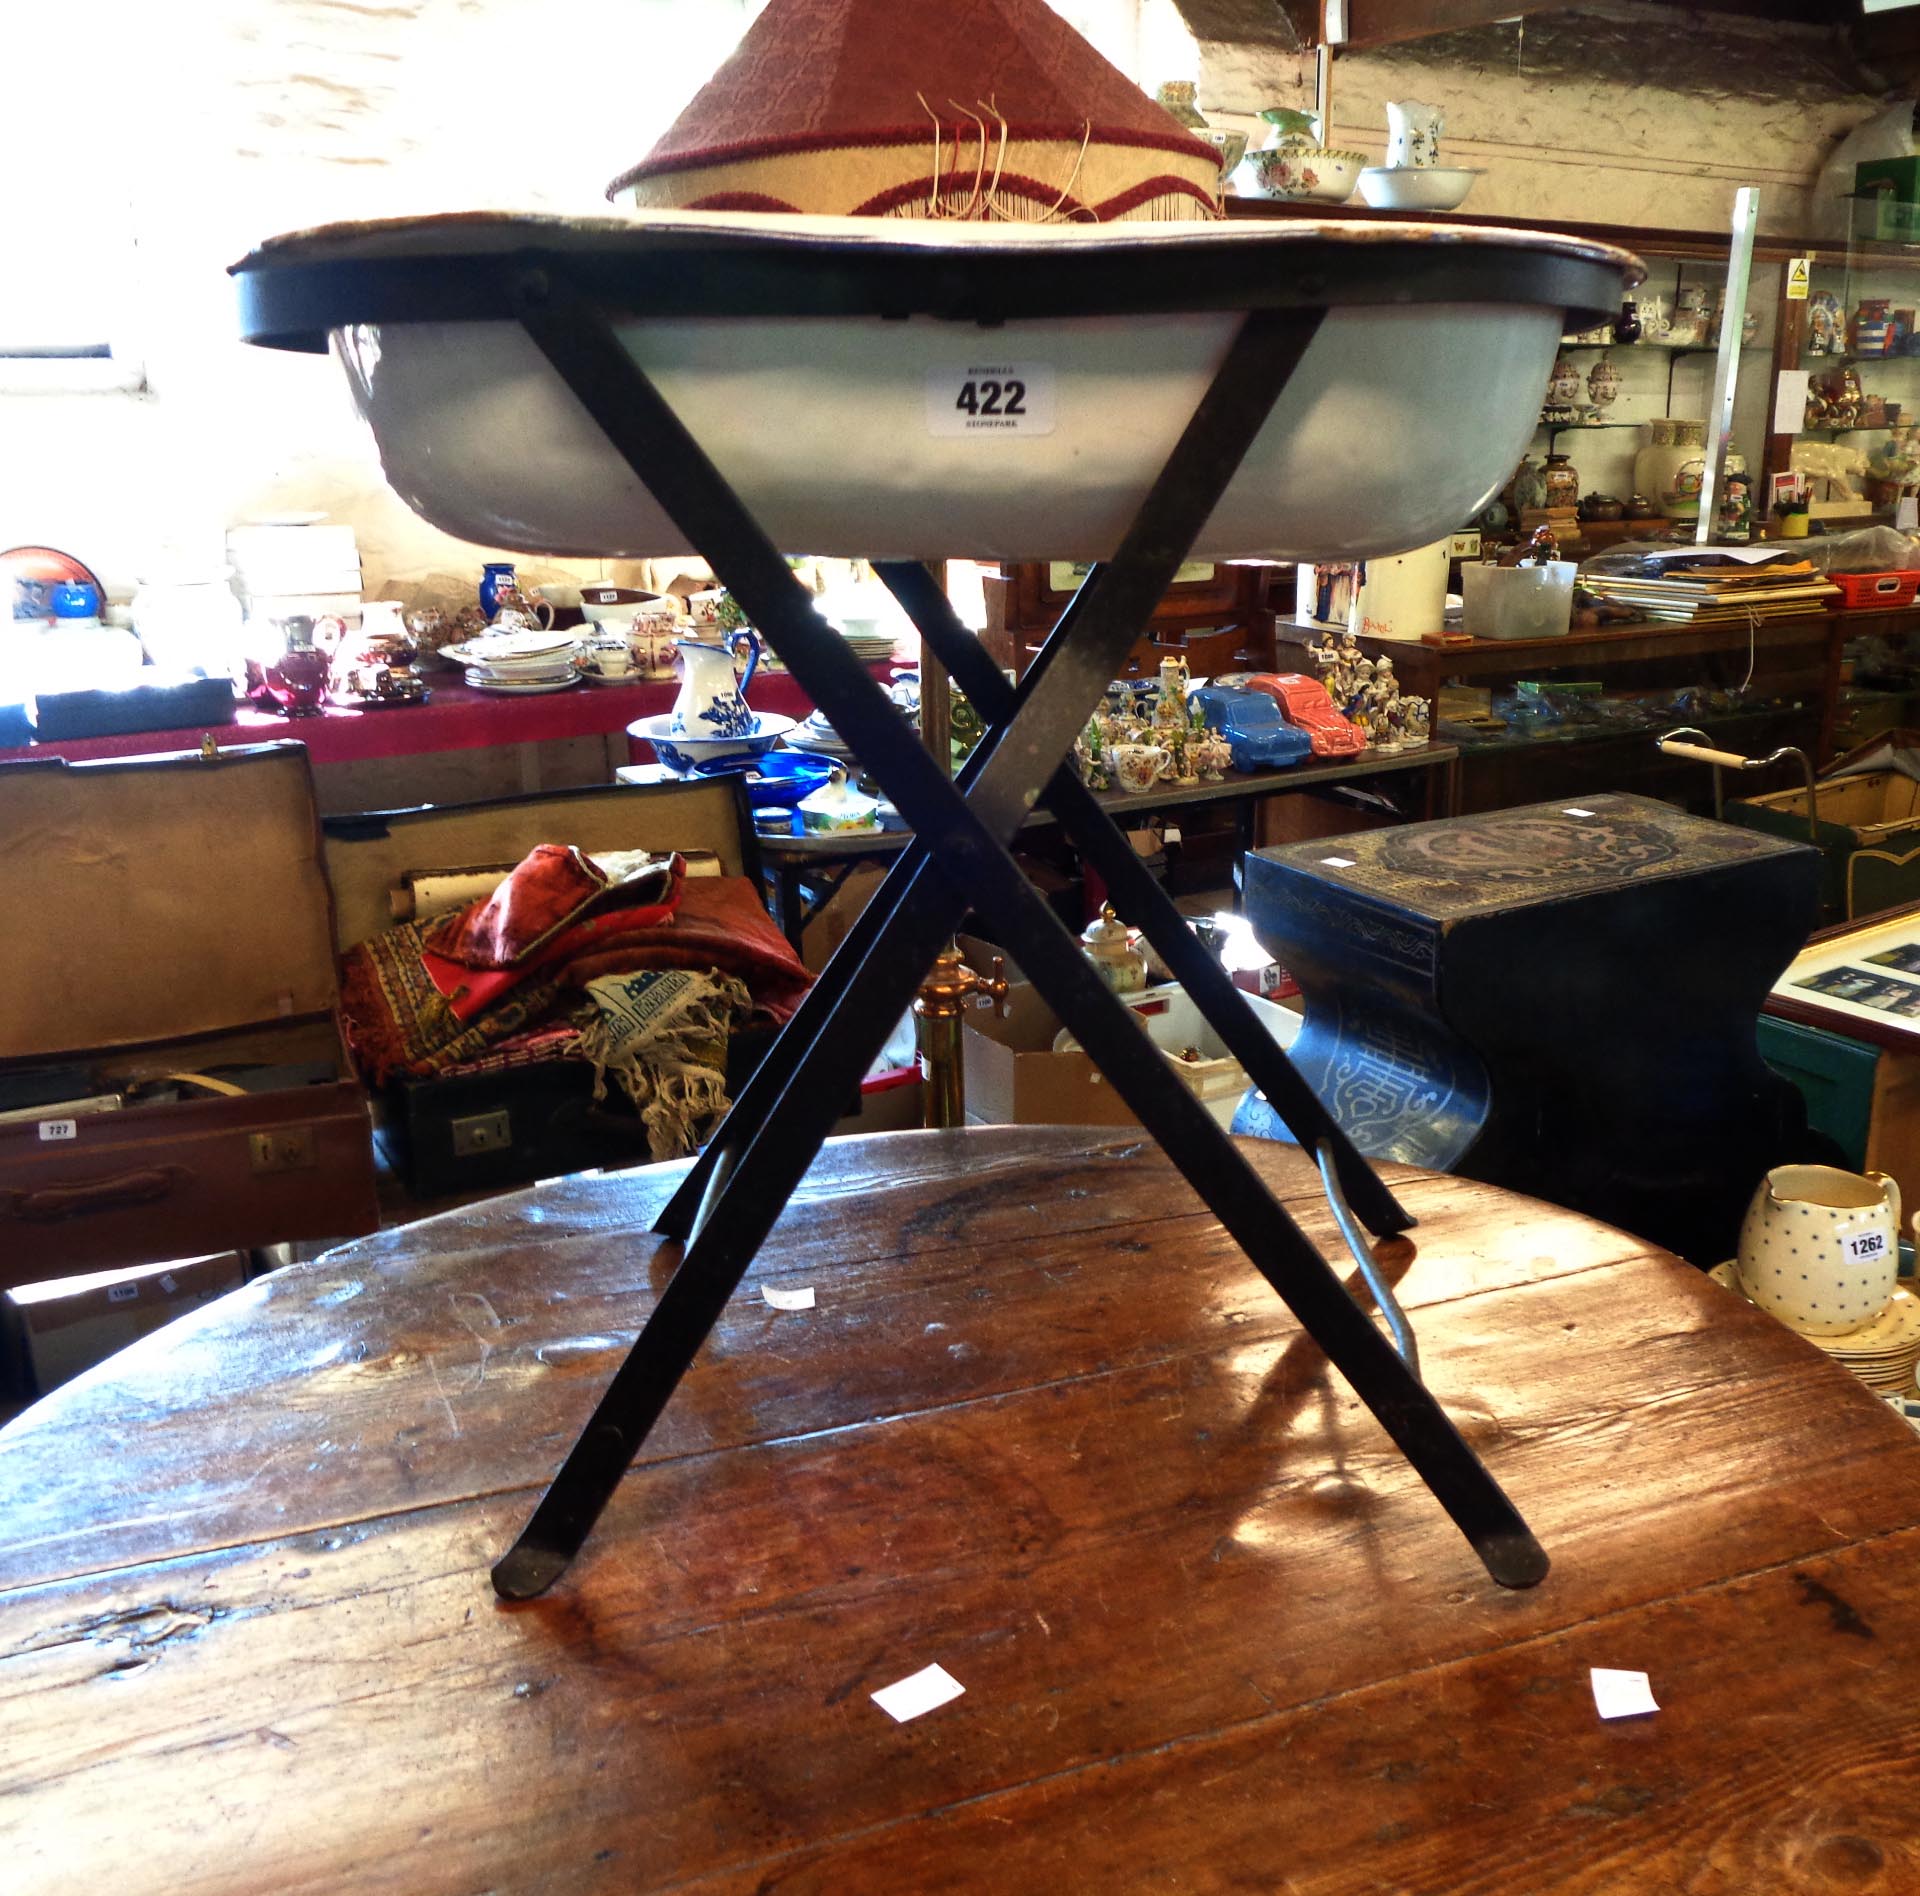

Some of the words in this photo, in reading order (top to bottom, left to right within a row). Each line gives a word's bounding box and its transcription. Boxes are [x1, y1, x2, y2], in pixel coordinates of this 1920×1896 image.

[956, 380, 1027, 416] 422
[49, 1124, 69, 1136] 727
[1850, 1234, 1884, 1256] 1262
